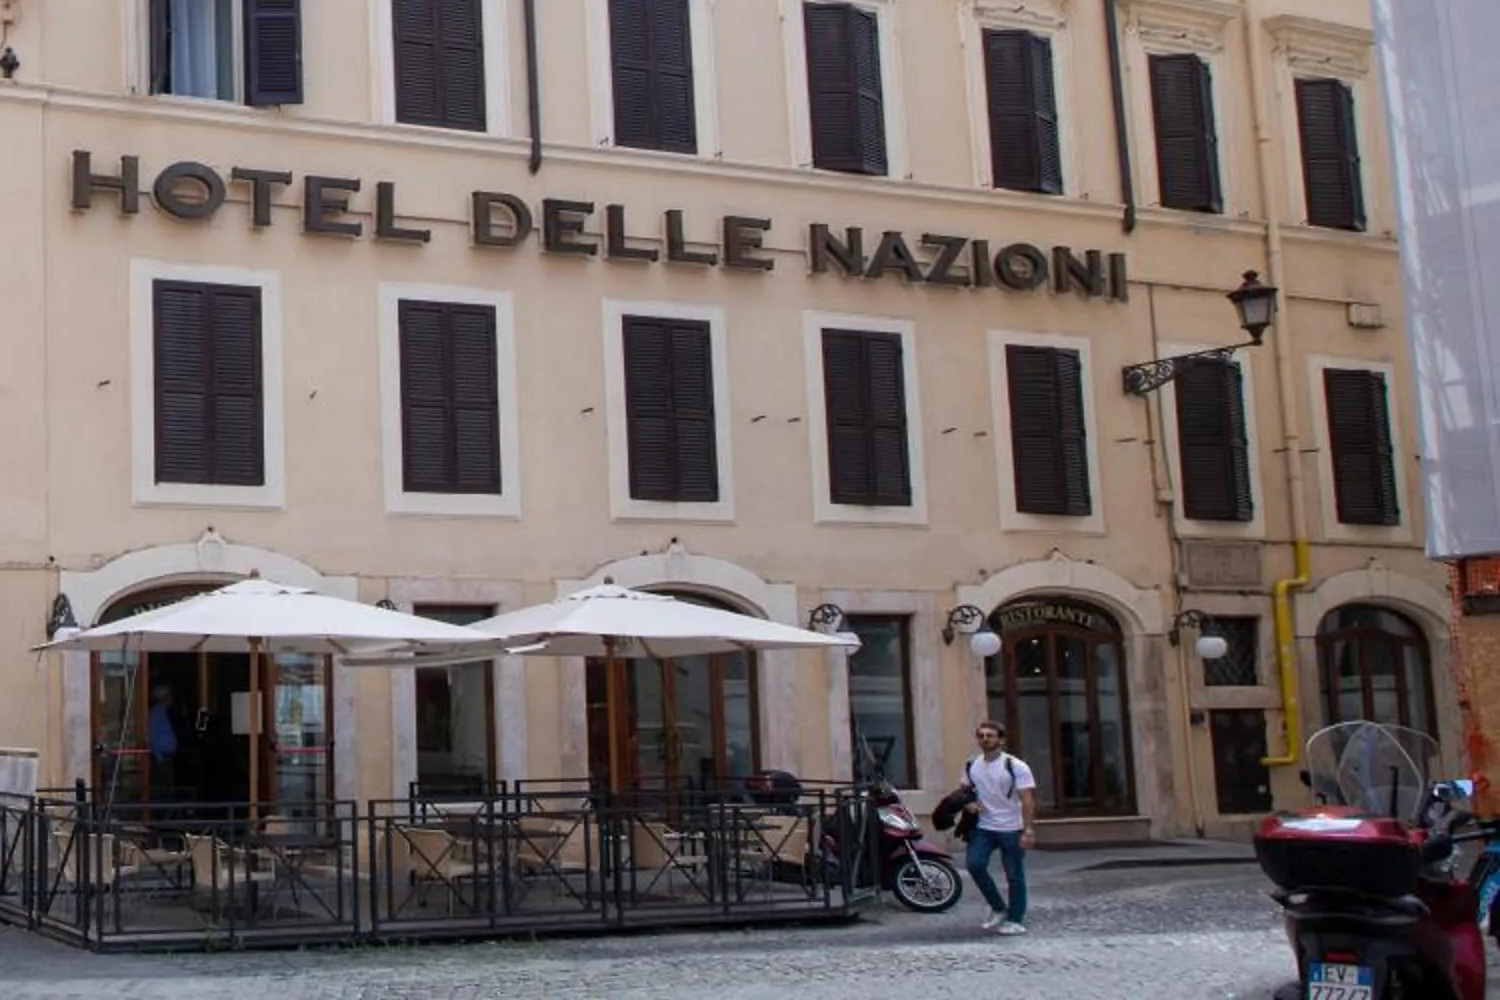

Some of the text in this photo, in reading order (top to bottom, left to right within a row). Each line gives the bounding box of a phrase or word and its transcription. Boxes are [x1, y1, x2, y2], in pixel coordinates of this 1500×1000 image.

[72, 150, 1129, 302] HOTEL DELLE NAZIONI
